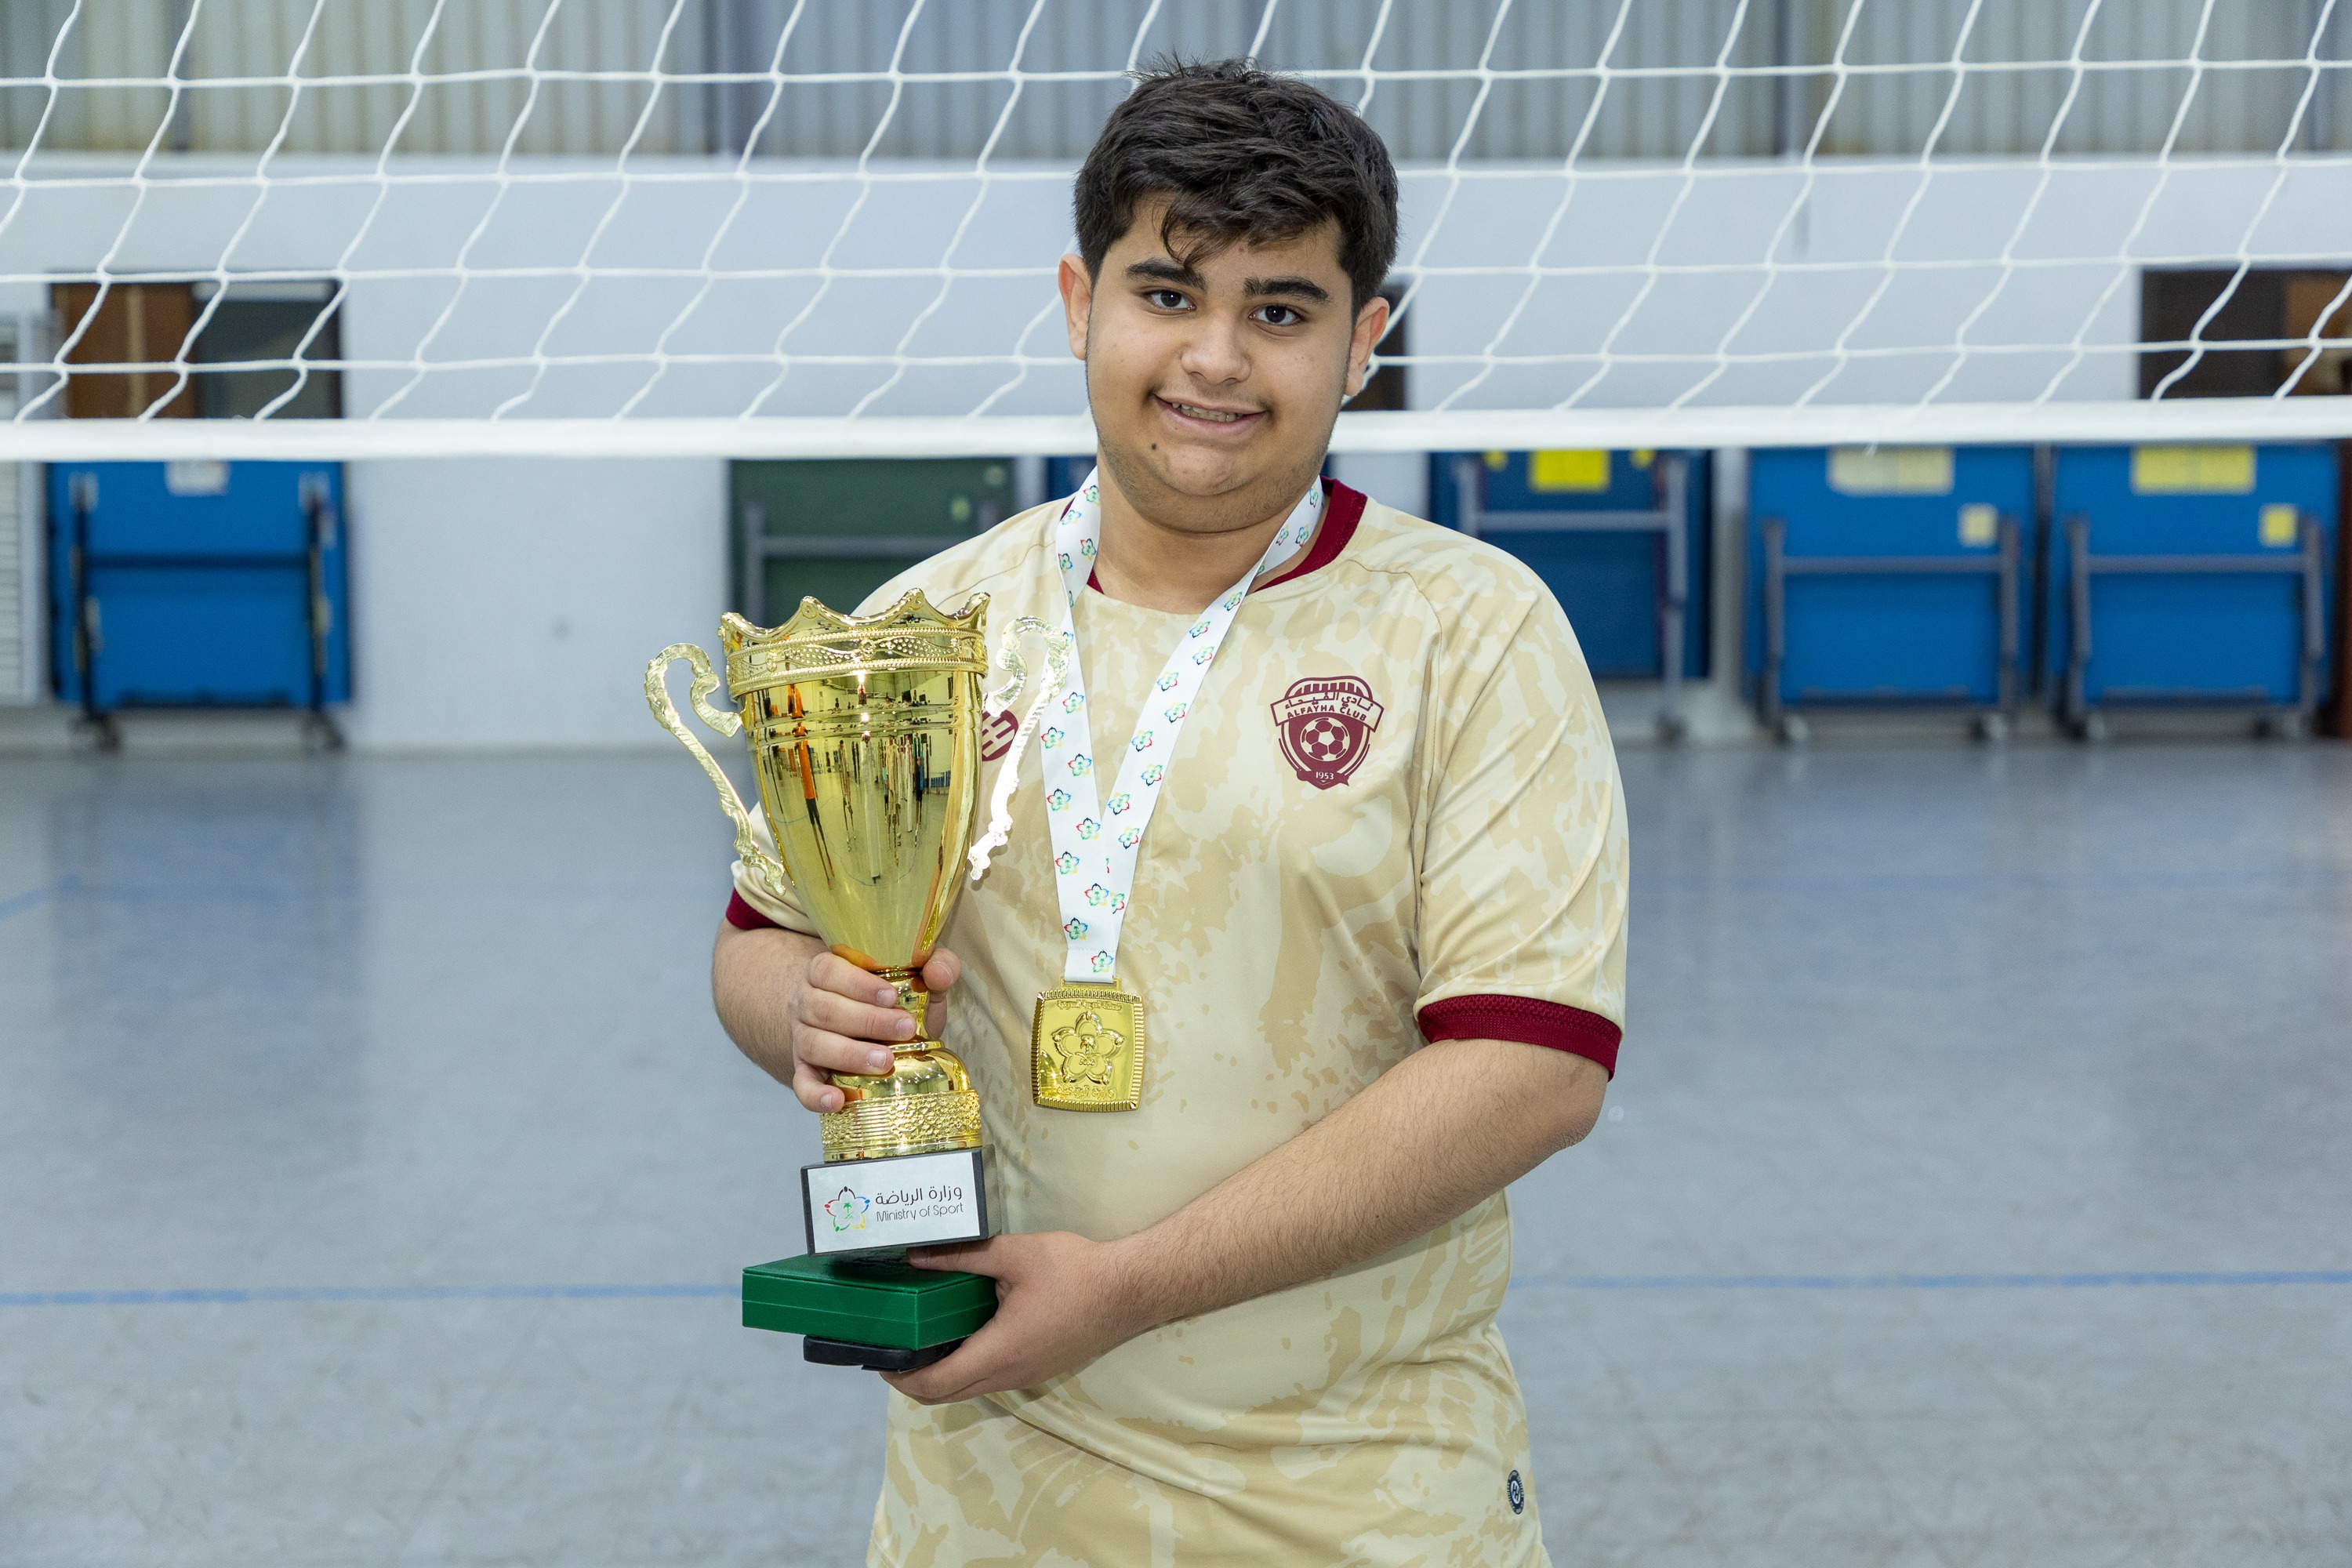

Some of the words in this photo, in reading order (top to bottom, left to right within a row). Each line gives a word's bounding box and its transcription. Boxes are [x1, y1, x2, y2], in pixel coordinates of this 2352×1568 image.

[1285, 691, 1340, 709] الفيحاء
[1341, 696, 1374, 711] نادي
[1287, 705, 1335, 719] ALFAYHA
[1339, 706, 1367, 721] CLUB
[1316, 771, 1334, 780] 1953
[875, 1187, 923, 1206] الرياضة
[928, 1185, 962, 1203] وزارة
[876, 1208, 916, 1222] Ministry
[919, 1205, 931, 1218] of
[933, 1202, 964, 1218] Sport
